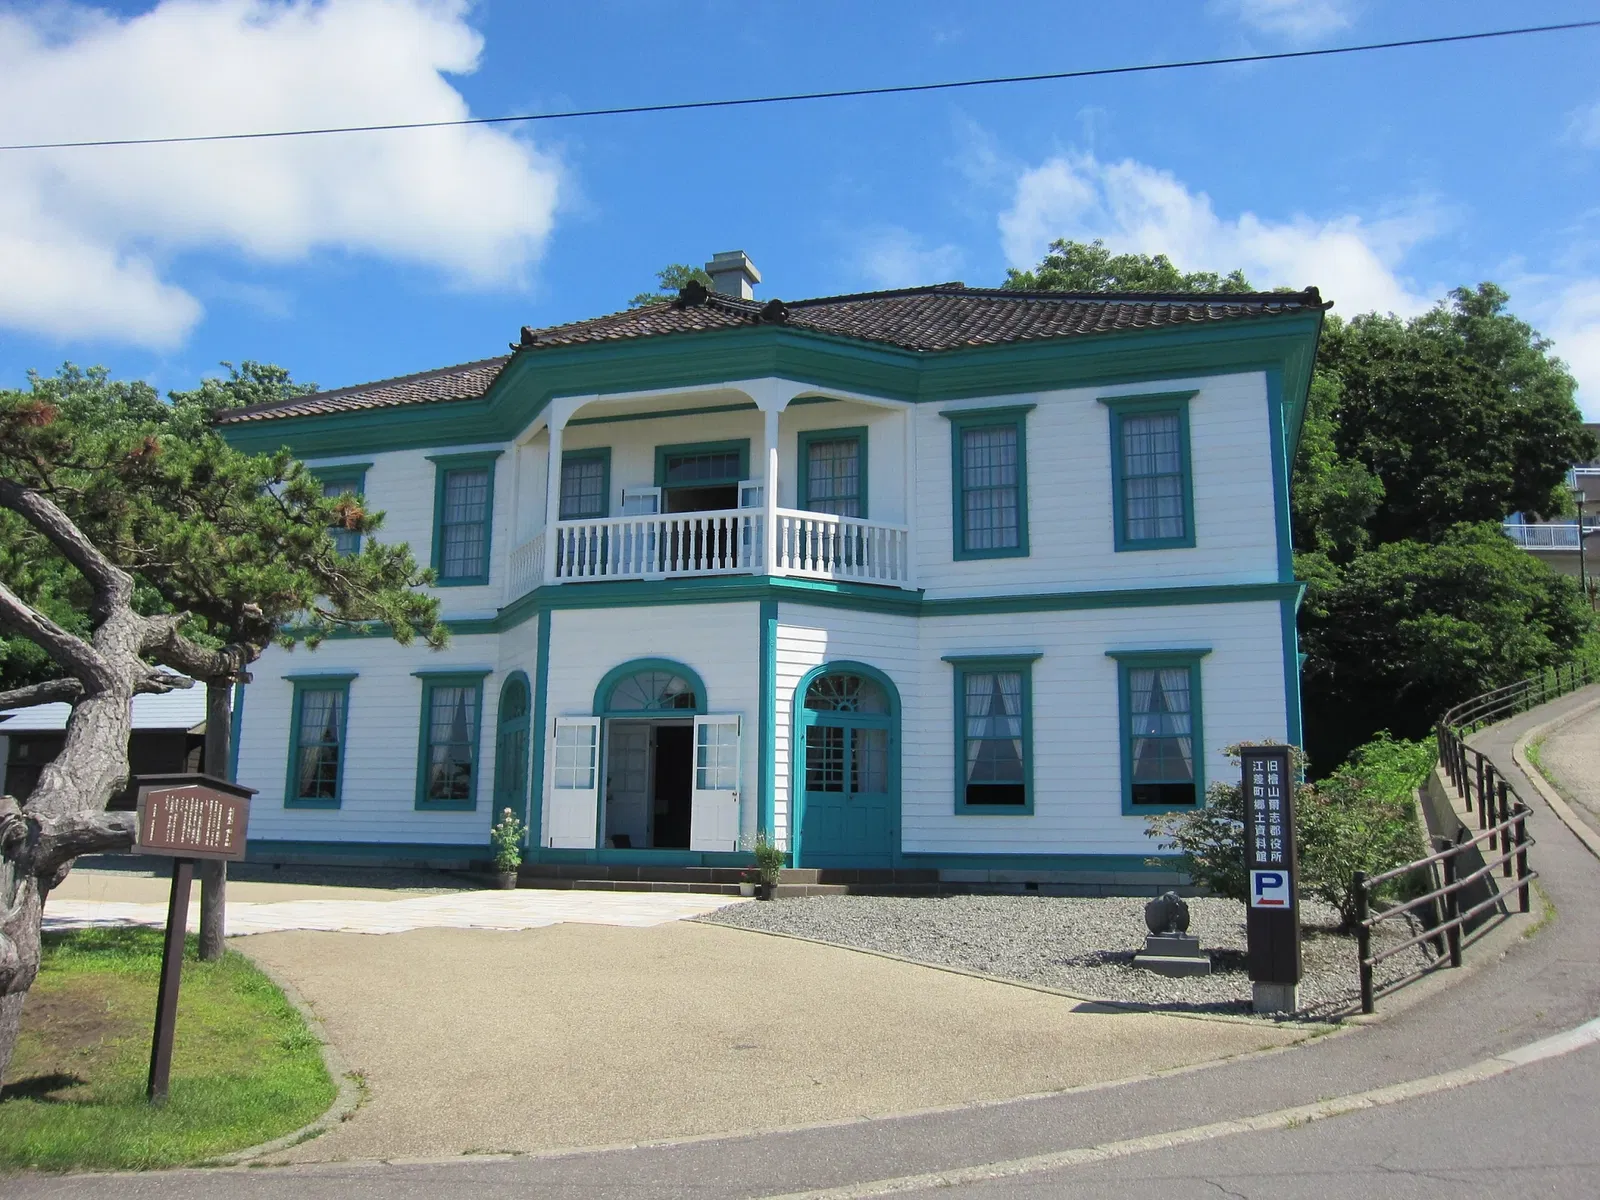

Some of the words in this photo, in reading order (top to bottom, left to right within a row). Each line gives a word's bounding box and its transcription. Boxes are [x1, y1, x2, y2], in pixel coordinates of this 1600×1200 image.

[1252, 760, 1267, 862] 江差町郷土資料館
[1267, 760, 1282, 862] 旧檜山爾志郡役所
[1255, 872, 1283, 896] P
